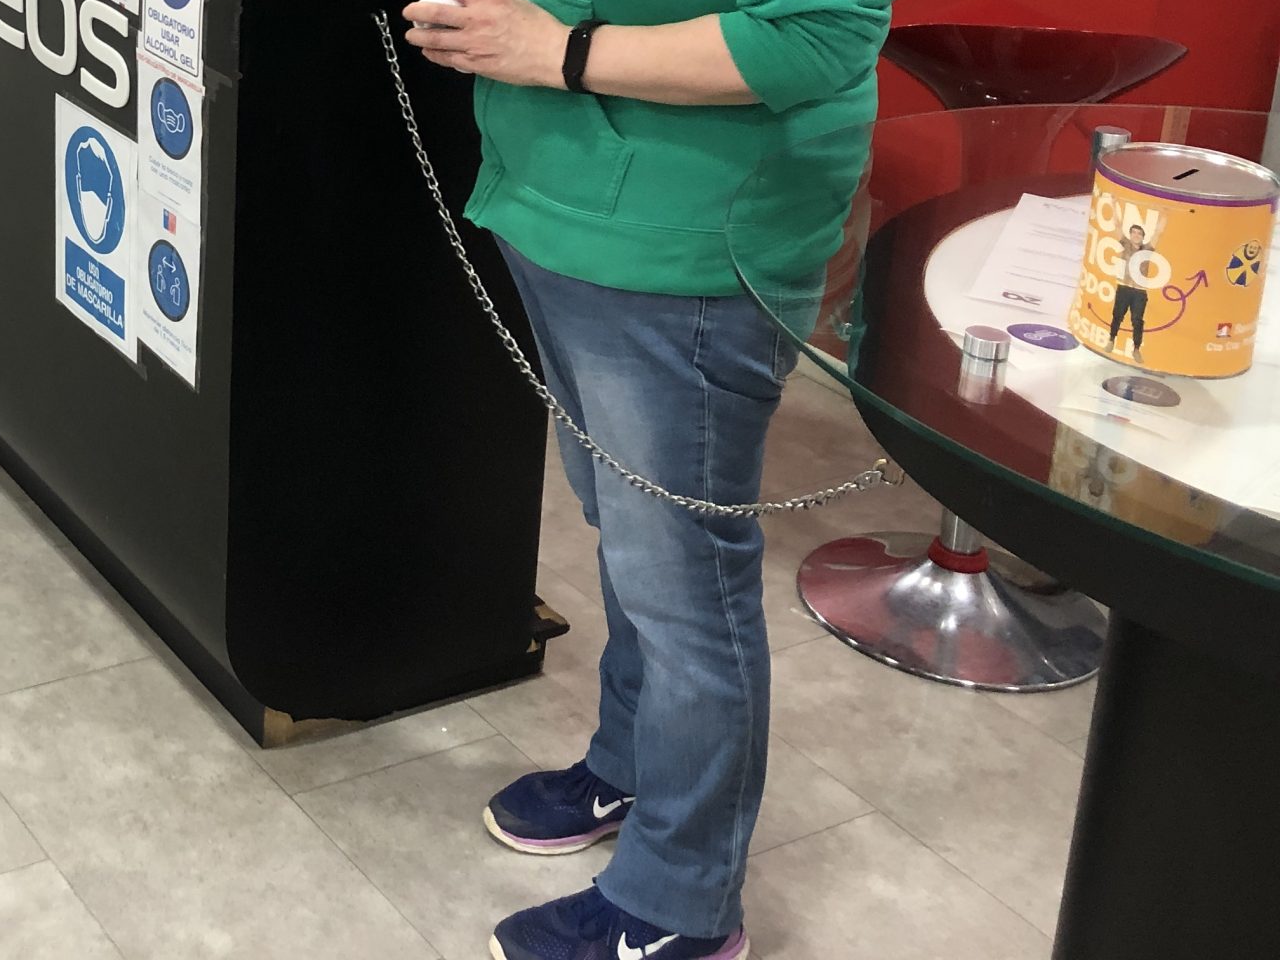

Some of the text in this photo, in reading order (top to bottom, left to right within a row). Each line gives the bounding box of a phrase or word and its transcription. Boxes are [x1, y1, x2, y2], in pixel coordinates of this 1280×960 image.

[147, 7, 196, 40] OBLIGATORIO
[160, 28, 180, 47] USAR
[146, 35, 195, 70] ALCOHOL GEL
[1091, 183, 1160, 246] ON
[76, 266, 113, 305] OBLIGATORIO
[88, 260, 100, 280] USO
[66, 272, 124, 329] DE MASCARILLA
